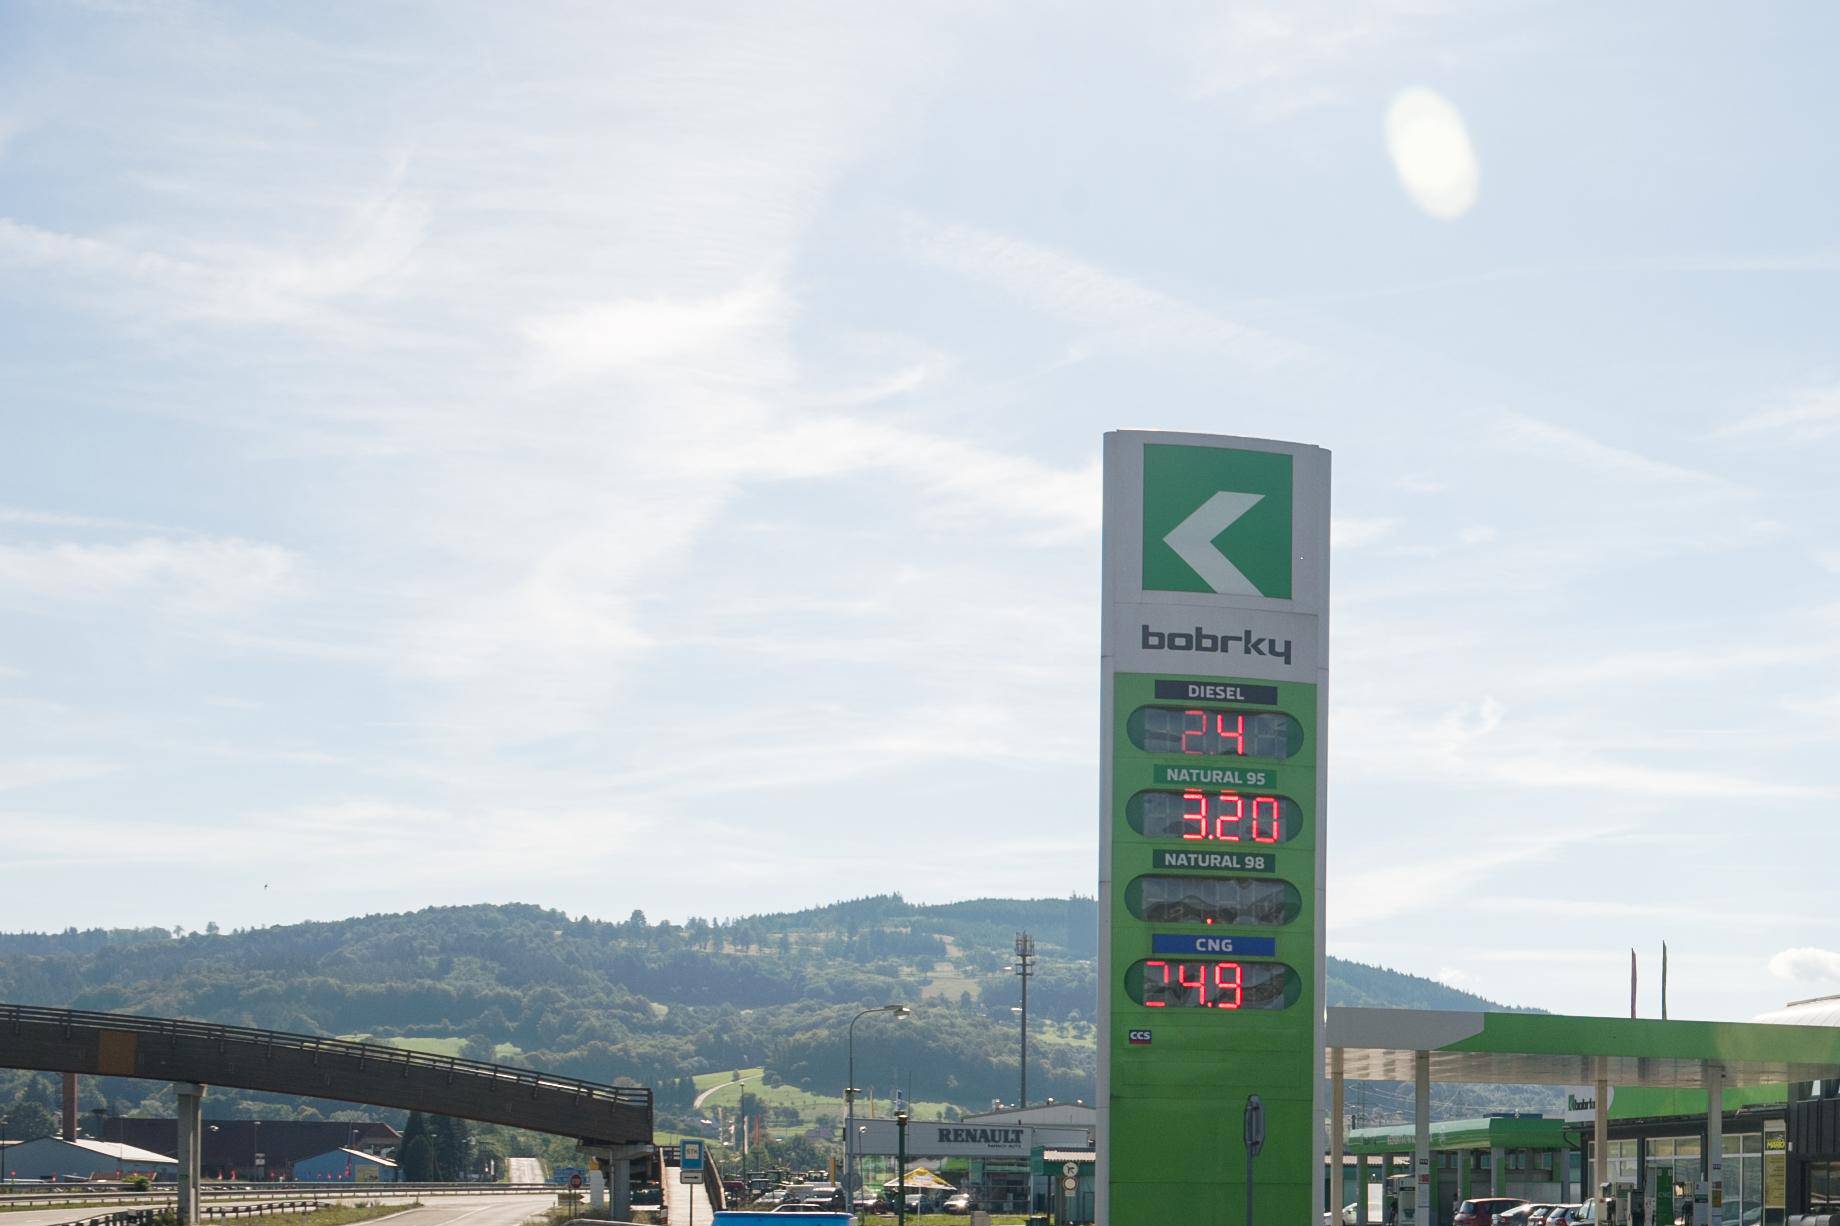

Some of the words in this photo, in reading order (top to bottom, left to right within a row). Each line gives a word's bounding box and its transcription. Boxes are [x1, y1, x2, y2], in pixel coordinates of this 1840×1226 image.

[1142, 624, 1292, 665] bobrky
[1188, 684, 1245, 700] DIESEL
[1166, 768, 1243, 785] NATURAL
[1246, 772, 1266, 786] 95
[1164, 852, 1241, 868] NATURAL
[1244, 856, 1265, 869] 98
[1195, 938, 1233, 953] CNG
[1130, 1031, 1150, 1040] CCS
[937, 1128, 1024, 1143] RENAULT
